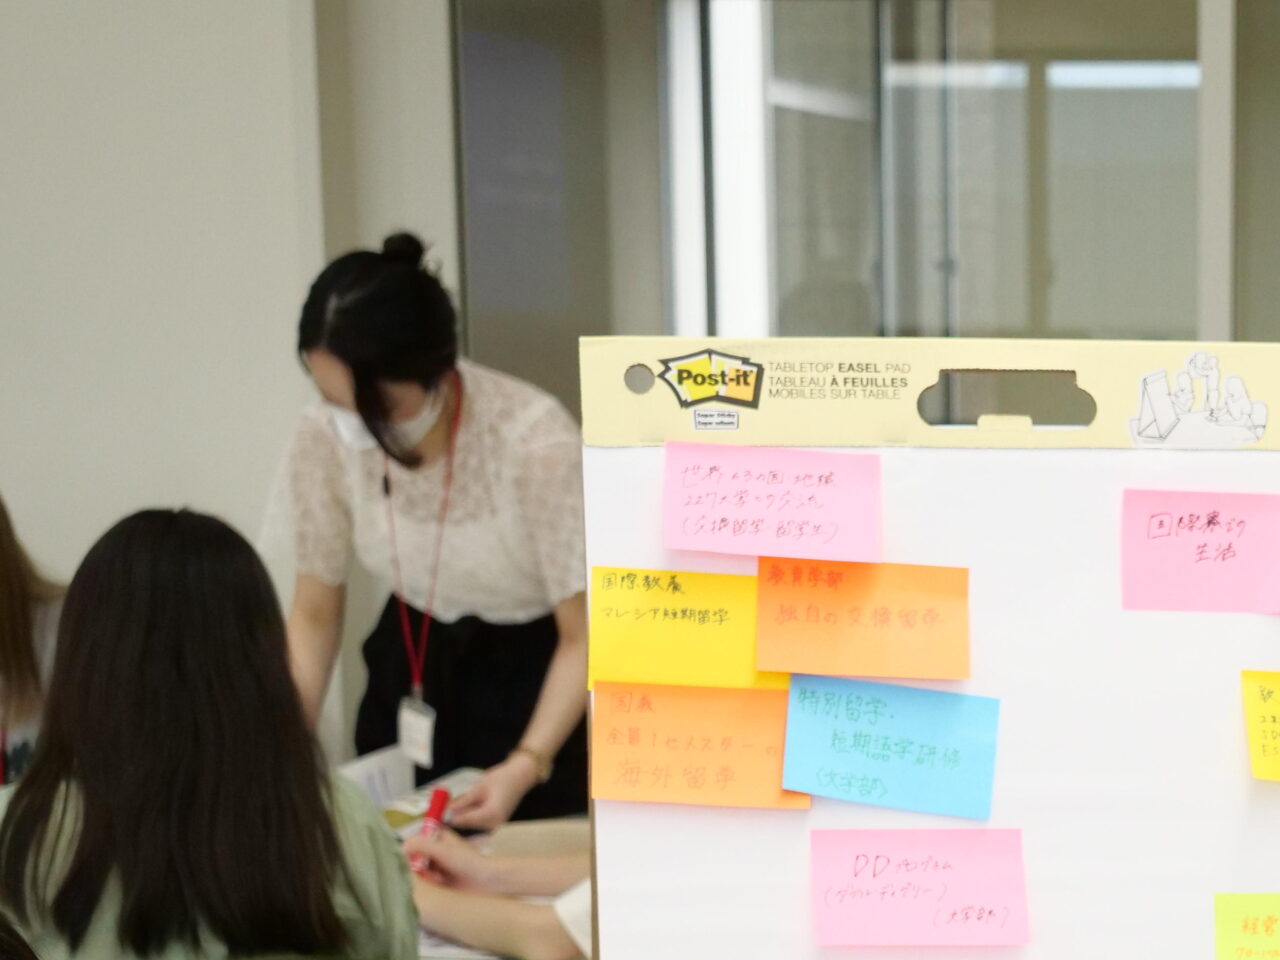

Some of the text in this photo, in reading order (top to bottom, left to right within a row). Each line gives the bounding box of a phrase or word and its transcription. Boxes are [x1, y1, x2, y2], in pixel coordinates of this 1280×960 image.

[677, 368, 751, 387] Post-it
[769, 362, 911, 374] TABLETOP EASEL PAD
[769, 374, 908, 388] TABLEAU À FEUILLES
[769, 388, 901, 400] MOBILES SUR TABLE
[1194, 543, 1237, 564] 生活
[600, 573, 687, 597] 国際教養
[600, 606, 731, 627] マレーシア短期留学
[774, 602, 945, 630] 独自の交換留学
[612, 760, 737, 791] 海外留学
